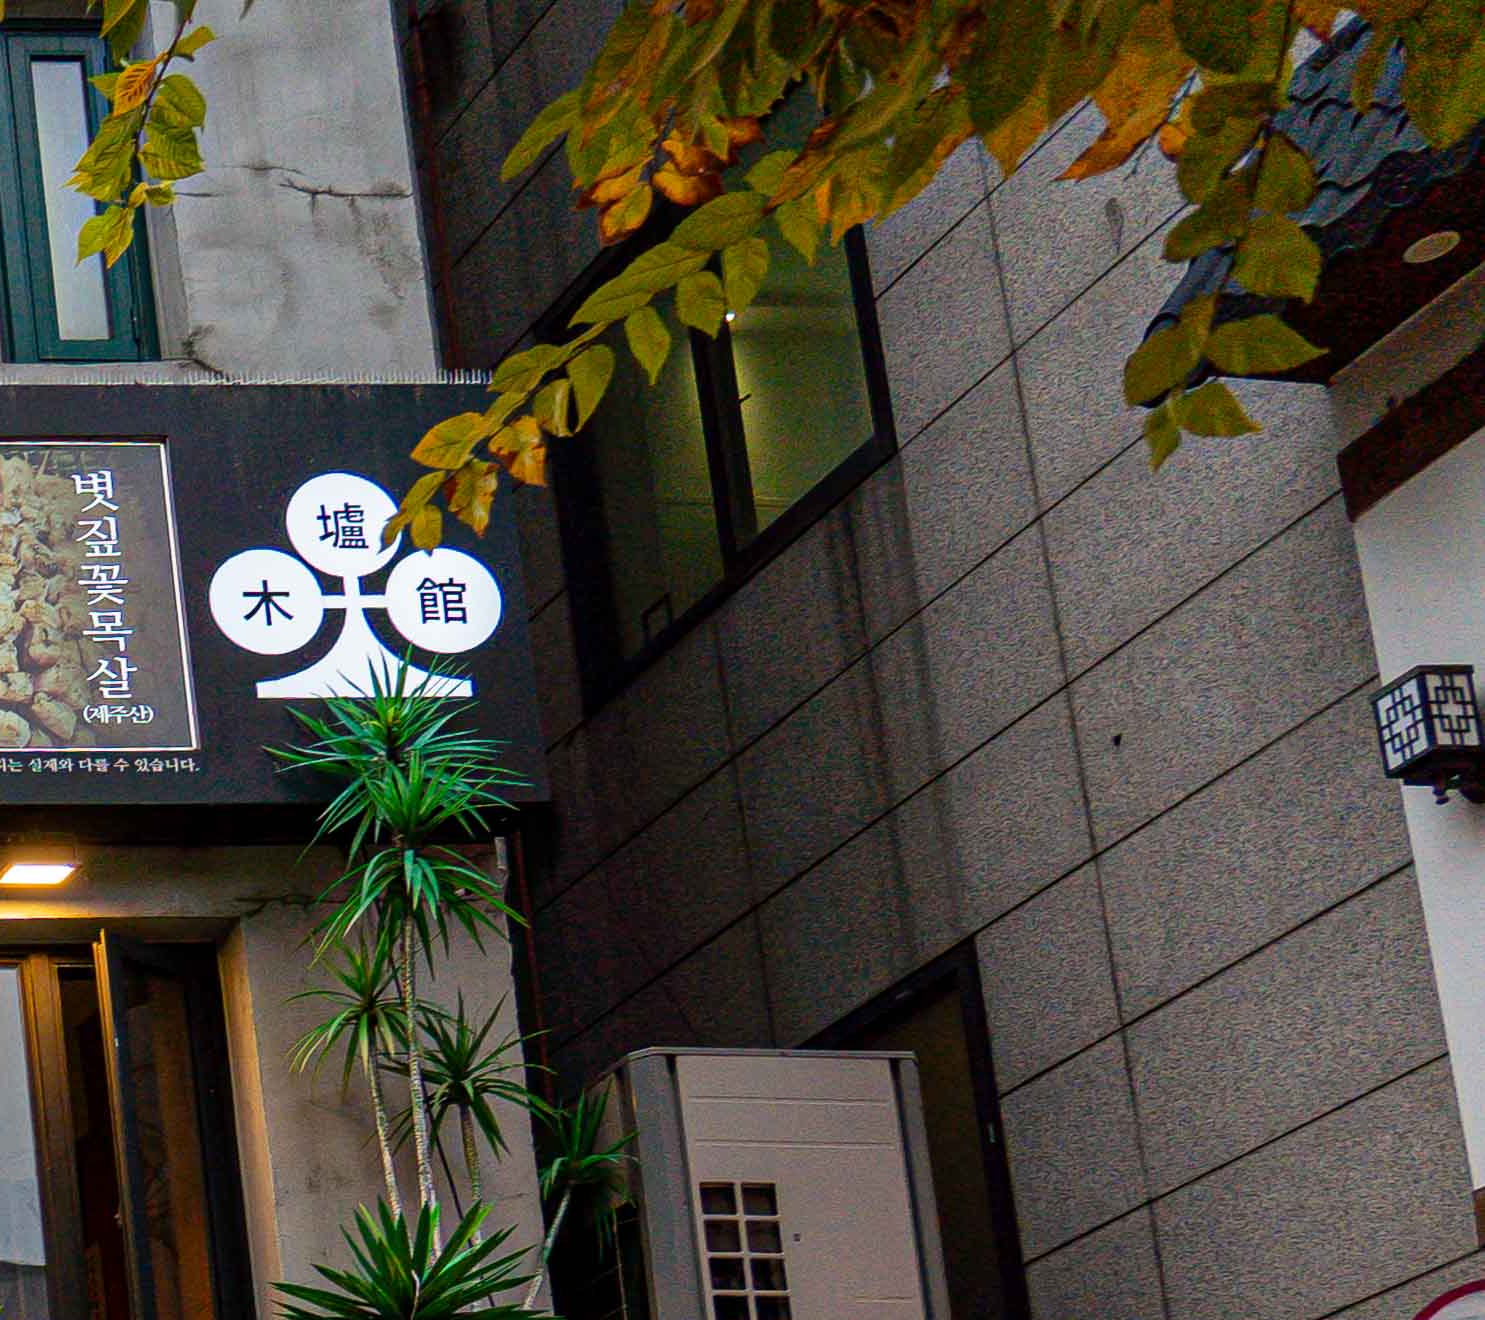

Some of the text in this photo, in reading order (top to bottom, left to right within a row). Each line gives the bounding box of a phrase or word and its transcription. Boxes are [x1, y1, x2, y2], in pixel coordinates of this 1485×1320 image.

[70, 469, 139, 700] 볏짚꽃목살
[241, 577, 468, 626] 木 館
[82, 704, 154, 726] (제주산)
[28, 758, 74, 773] 실제와
[78, 758, 110, 773] 다를
[114, 759, 130, 773] 수
[134, 758, 201, 774] 있습니다.
